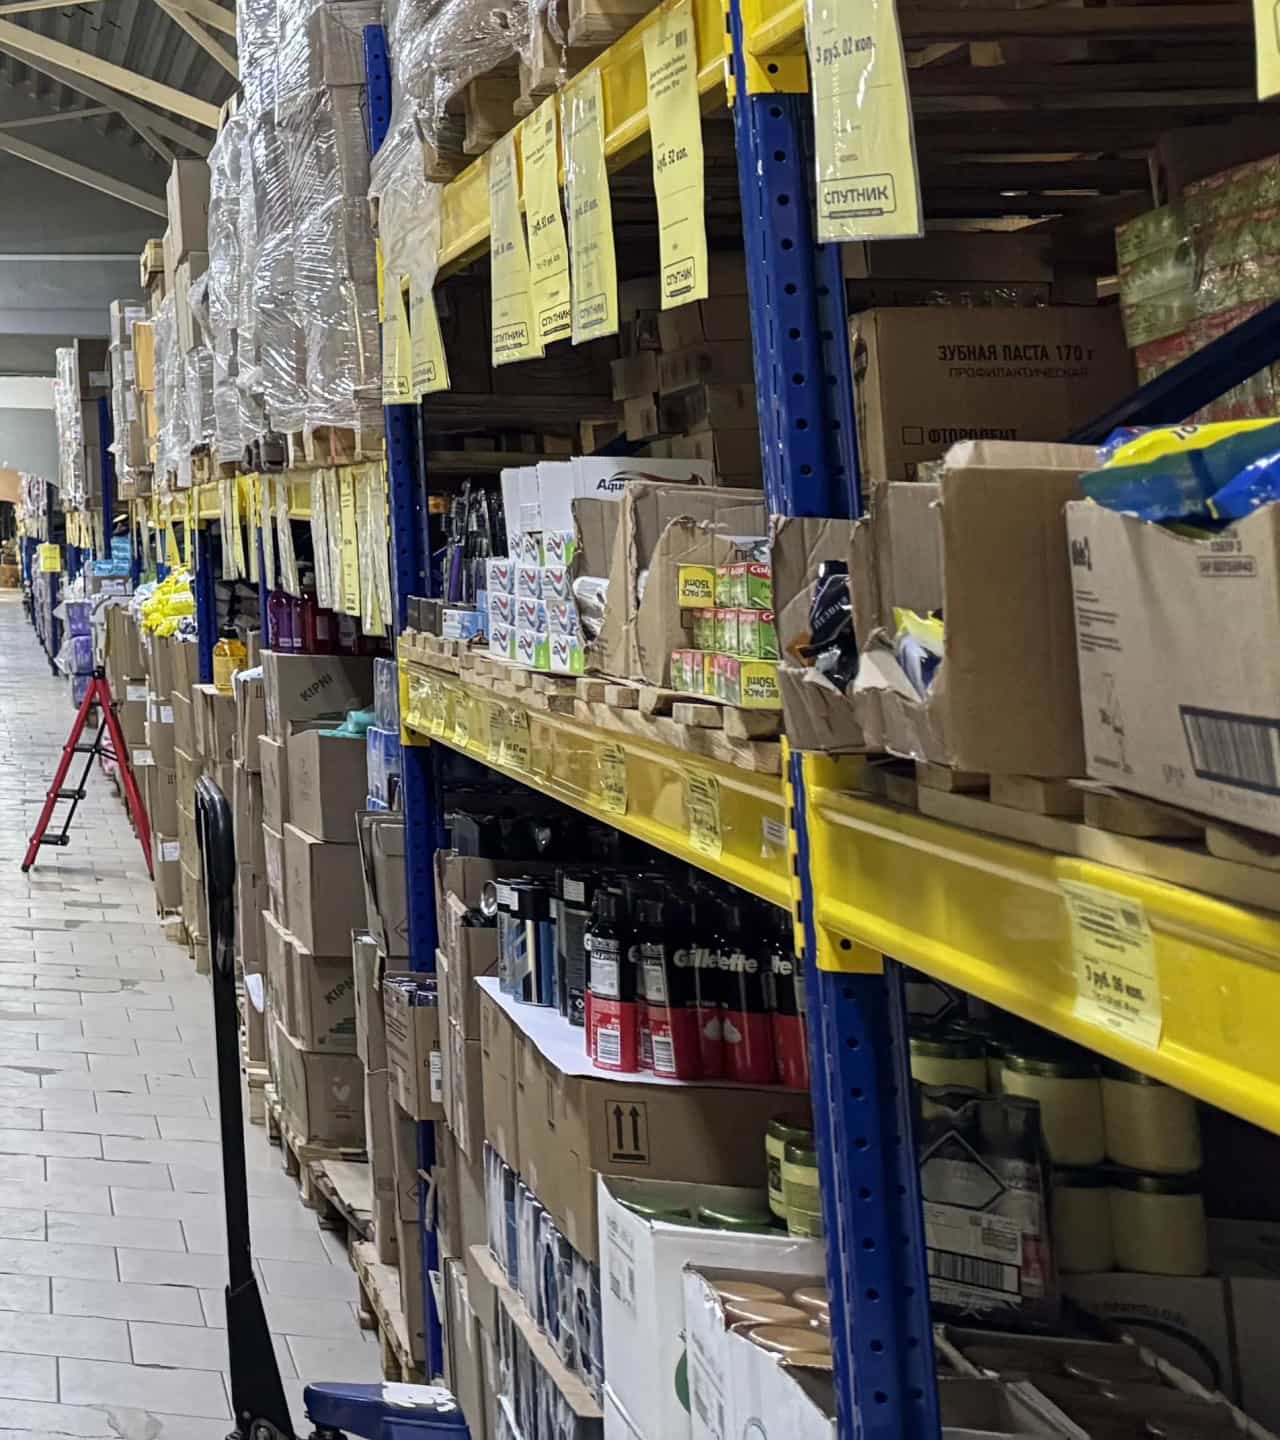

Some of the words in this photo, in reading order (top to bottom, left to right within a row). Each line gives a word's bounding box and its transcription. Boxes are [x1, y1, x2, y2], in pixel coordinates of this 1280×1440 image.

[816, 47, 822, 62] 3
[842, 36, 853, 56] 02
[855, 36, 876, 52] коп.
[824, 186, 890, 205] СПУТНИК
[667, 268, 693, 287] СПУТНИК
[937, 344, 998, 361] ЗУБНАЯ
[1002, 344, 1049, 361] ПАСТА
[1055, 344, 1083, 361] 170
[948, 367, 1089, 378] ПРОФИЛАКТИЧЕСКАЯ
[684, 578, 710, 589] 150ml
[746, 676, 777, 688] 150ml
[744, 688, 766, 699] PACK
[324, 976, 354, 1004] KIPN
